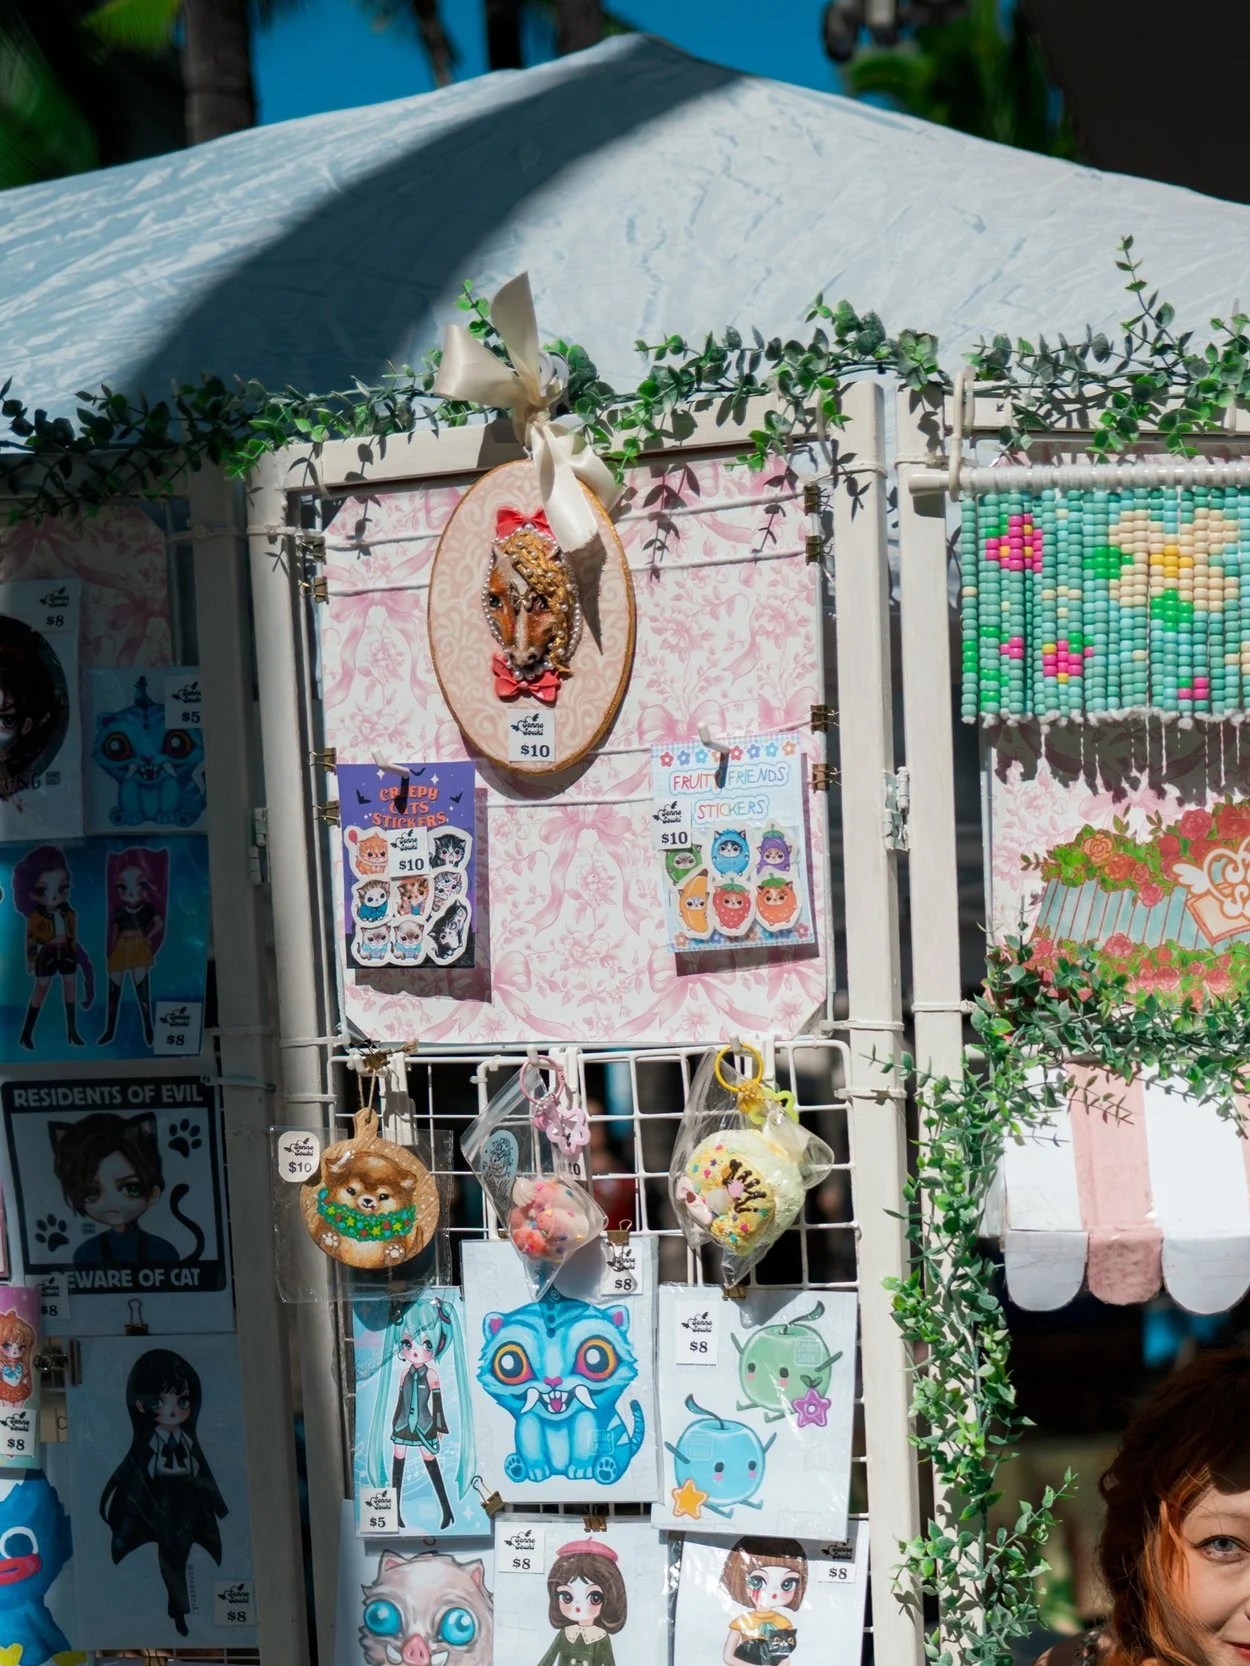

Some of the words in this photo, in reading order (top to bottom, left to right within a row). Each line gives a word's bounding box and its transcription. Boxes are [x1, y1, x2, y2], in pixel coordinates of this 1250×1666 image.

[46, 616, 64, 626] $8
[182, 711, 200, 723] $5
[521, 744, 550, 757] $10
[728, 766, 786, 786] FRIENDS
[697, 800, 765, 820] STICKERS
[372, 812, 448, 829] STICKERS
[661, 831, 687, 845] $10
[399, 858, 424, 870] $10
[166, 1035, 184, 1046] $8
[14, 1086, 122, 1108] RESIDENTS
[128, 1086, 155, 1105] OF
[162, 1084, 203, 1104] EVIL
[289, 1162, 312, 1173] $10
[52, 1270, 132, 1289] EWARE
[139, 1268, 166, 1288] OF
[171, 1268, 201, 1287] CAT
[615, 1279, 631, 1290] $8
[690, 1342, 707, 1353] $8
[8, 1439, 25, 1450] $8
[370, 1516, 385, 1528] $5
[512, 1558, 530, 1569] $8
[829, 1567, 847, 1579] $8
[227, 1611, 246, 1622] $8
